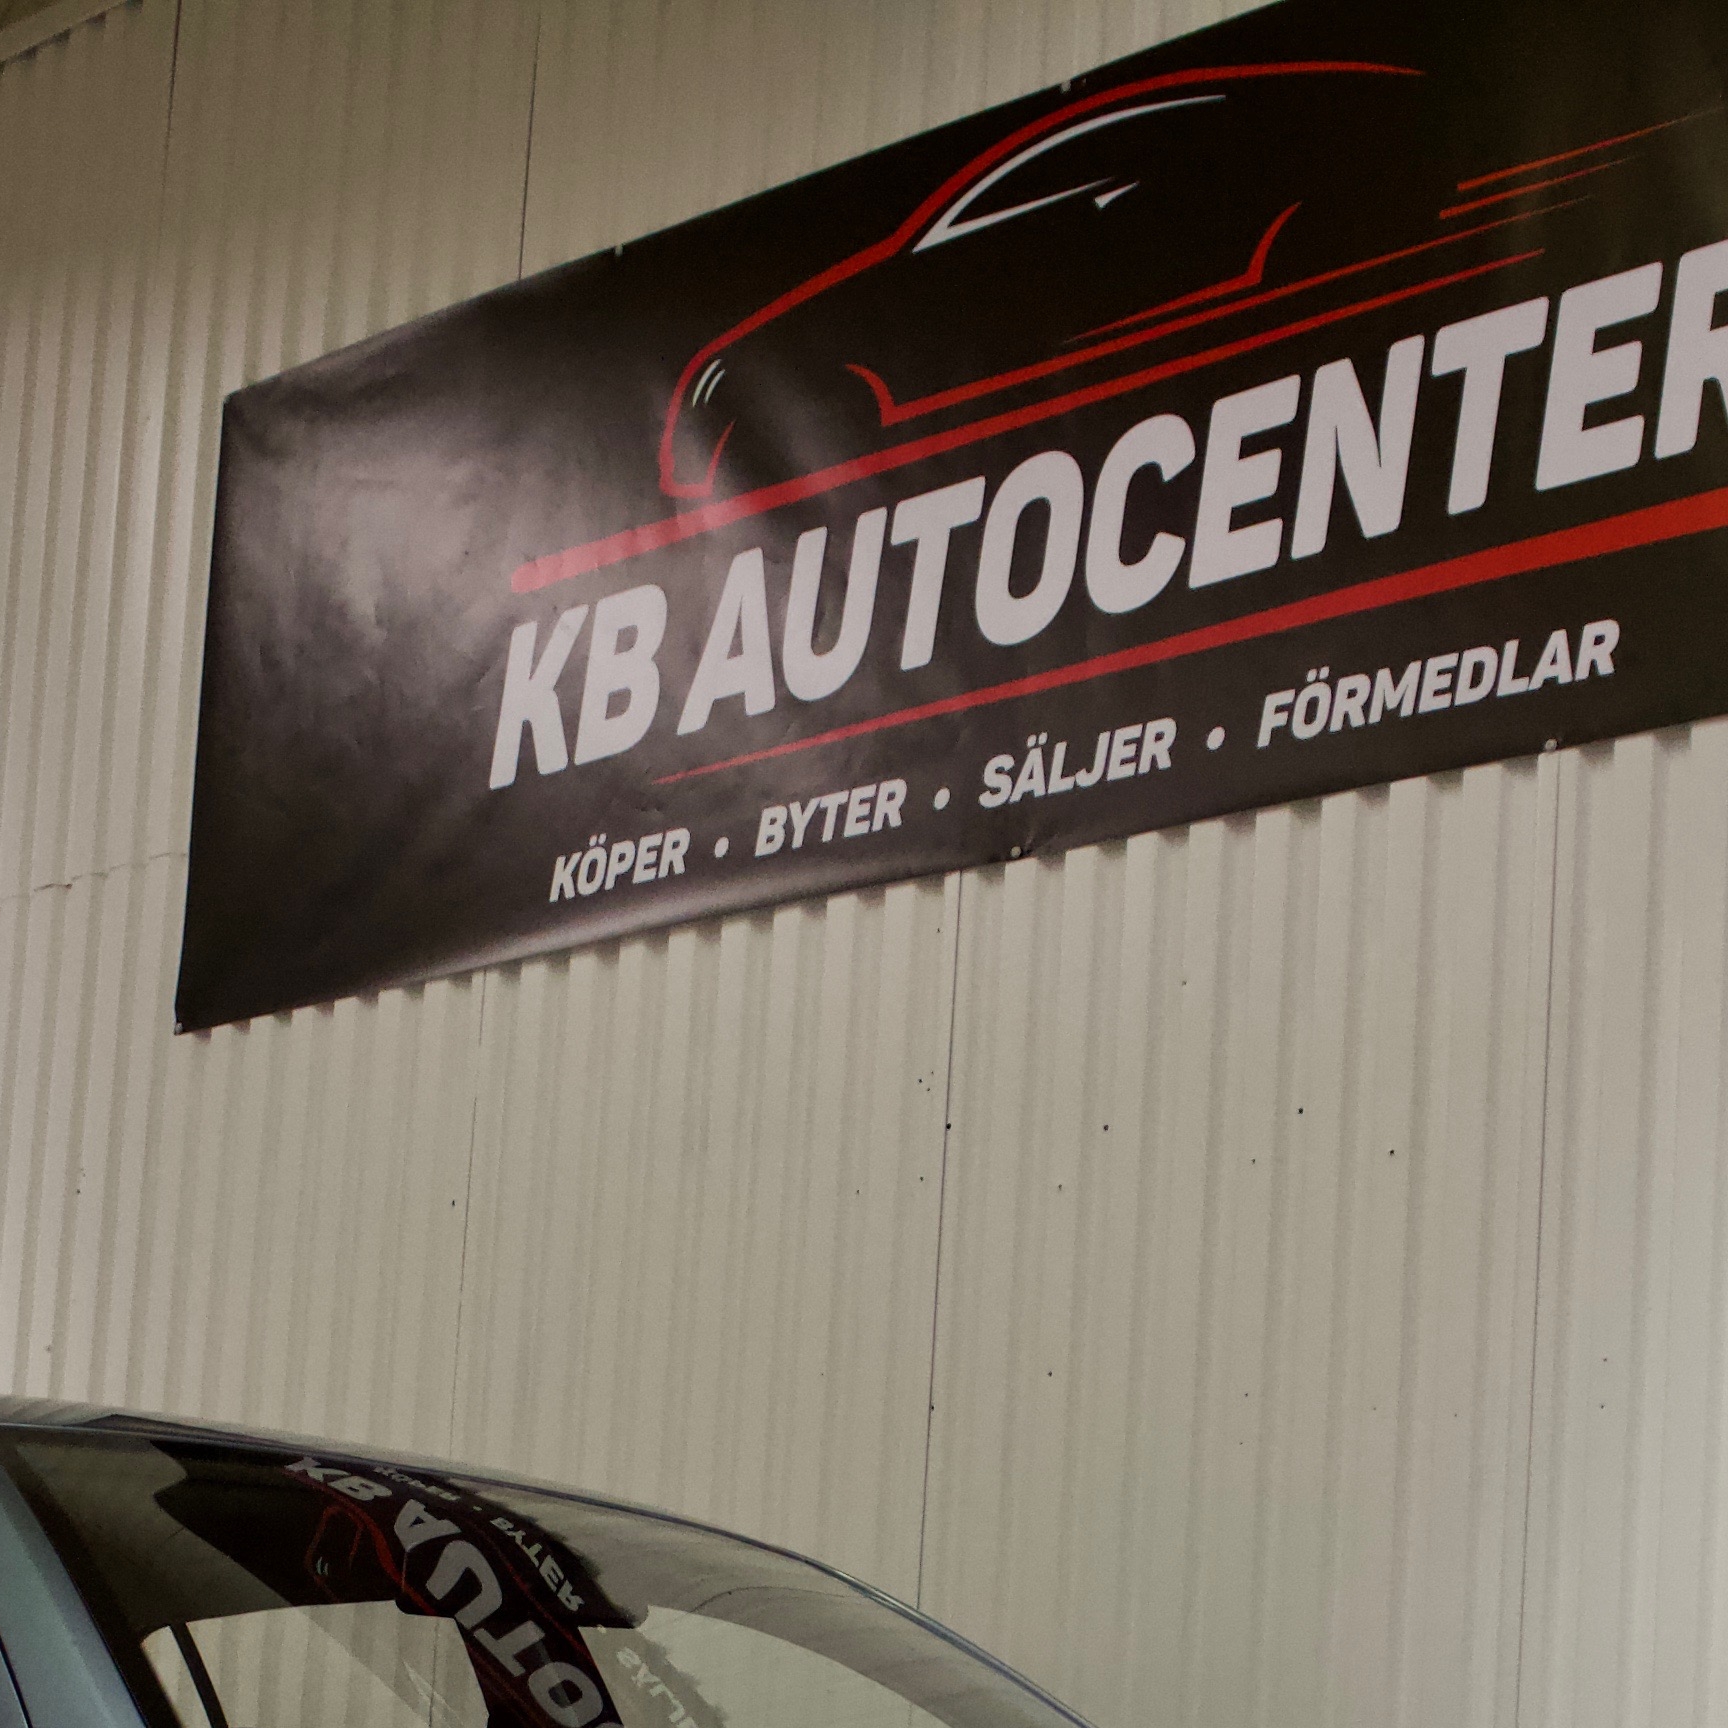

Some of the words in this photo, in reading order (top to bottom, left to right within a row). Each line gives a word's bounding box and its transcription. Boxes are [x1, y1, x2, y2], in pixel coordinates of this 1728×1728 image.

[488, 583, 669, 790] KB
[548, 826, 692, 903] KÖPER
[754, 778, 909, 858] BYTER
[978, 717, 1178, 809] SÄLJER
[1256, 618, 1621, 751] FÖRMEDLAR
